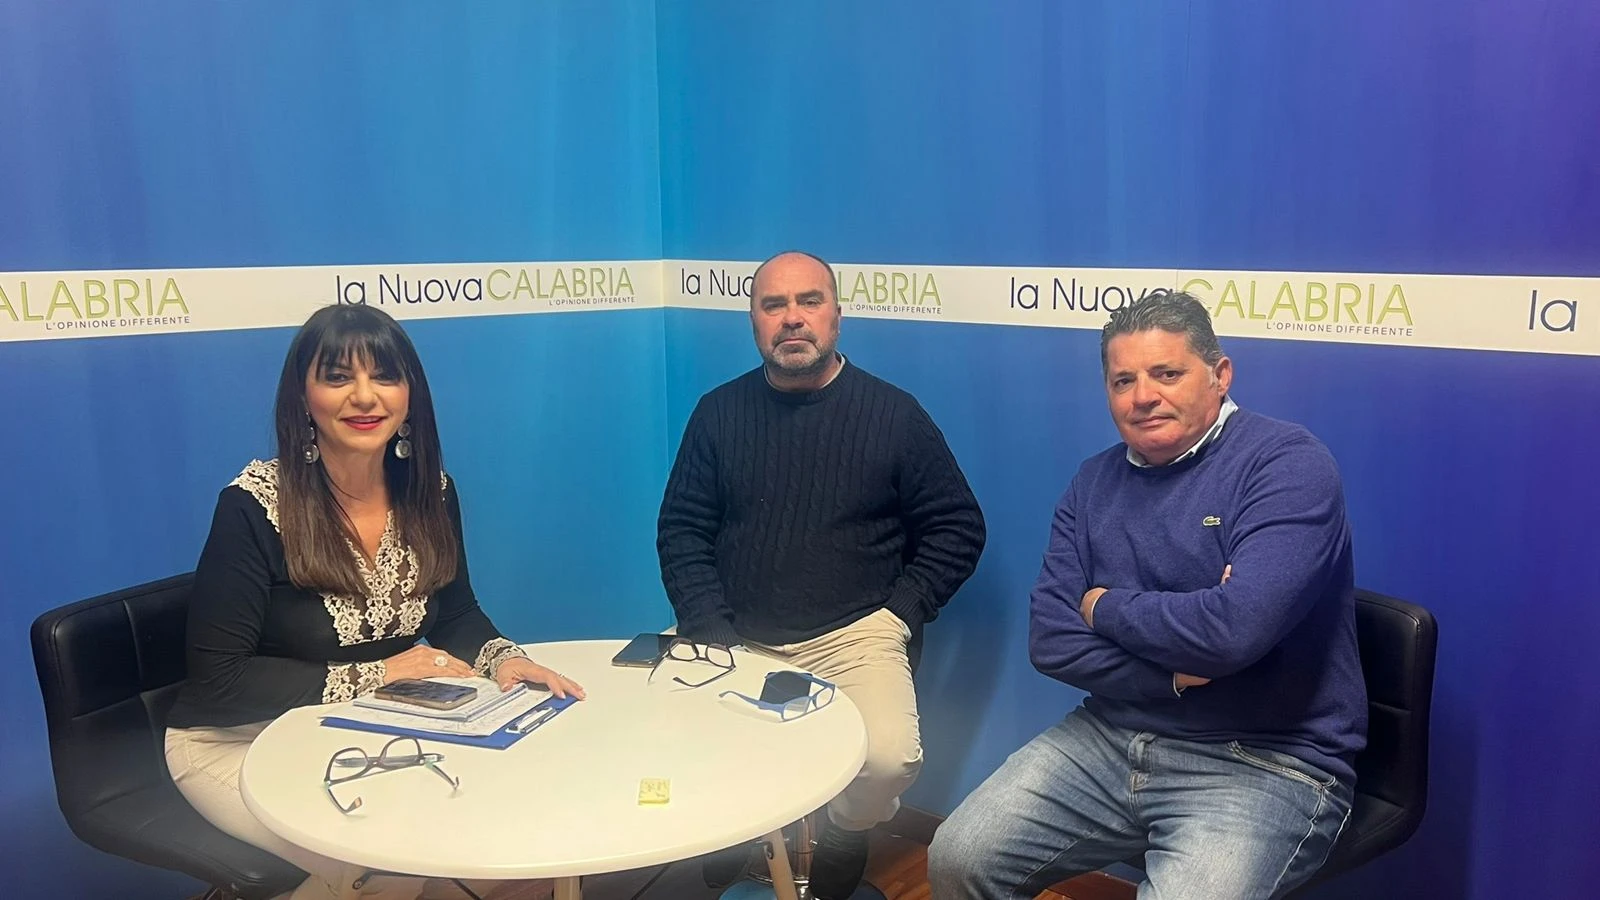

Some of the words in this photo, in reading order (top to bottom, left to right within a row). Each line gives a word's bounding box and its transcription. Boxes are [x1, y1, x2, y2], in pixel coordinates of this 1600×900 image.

[336, 275, 366, 304] la
[682, 268, 700, 294] la
[710, 269, 754, 297] Nuo
[838, 271, 941, 306] LABRIA
[1011, 277, 1039, 310] la
[46, 320, 116, 330] L'OPINIONE
[120, 316, 190, 327] DIFFERENTE
[849, 304, 891, 312] L'OPINIONE
[894, 306, 942, 314] DIFFERENTE
[1529, 289, 1577, 332] la
[1267, 321, 1332, 332] L'OPINIONE
[1336, 325, 1413, 337] DIFFERENTE
